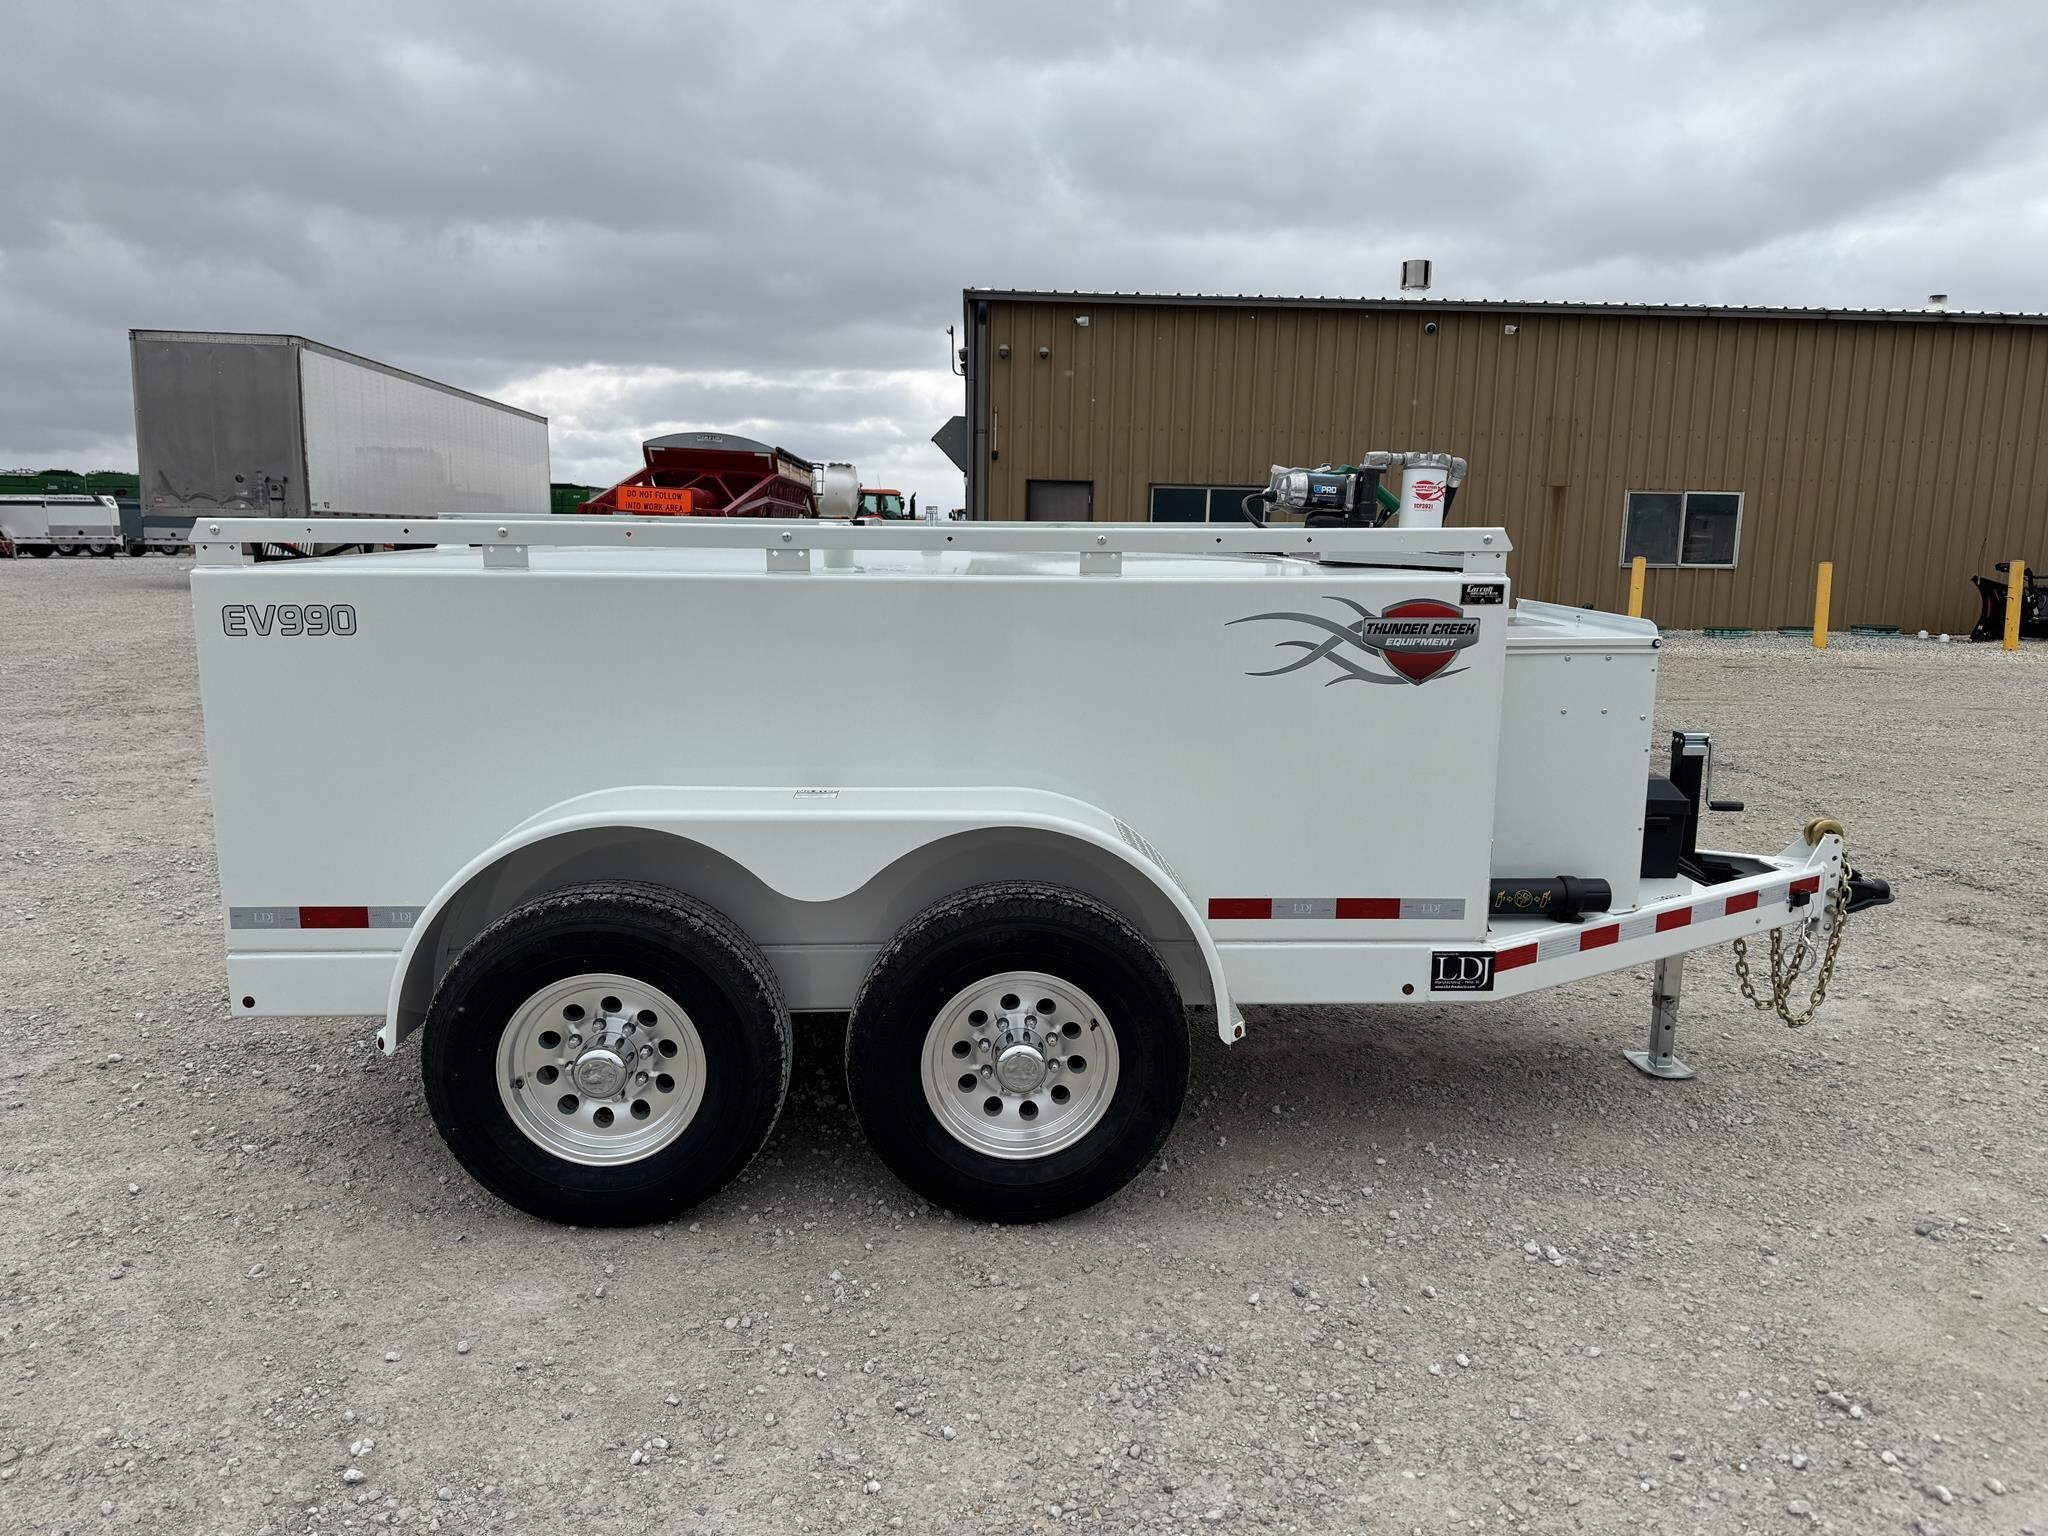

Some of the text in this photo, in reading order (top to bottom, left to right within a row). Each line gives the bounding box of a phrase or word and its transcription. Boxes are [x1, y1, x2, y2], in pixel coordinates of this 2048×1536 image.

[655, 491, 683, 500] FOLLOW
[625, 502, 684, 513] INTO WORK AREA
[221, 604, 357, 637] EV990
[1366, 623, 1477, 635] THUNDER CREEK
[1385, 638, 1457, 647] EQUIPMENT
[1293, 904, 1312, 913] LDJ
[252, 912, 274, 923] LDJ
[391, 911, 413, 923] LDJ
[1435, 956, 1494, 988] LDJ
